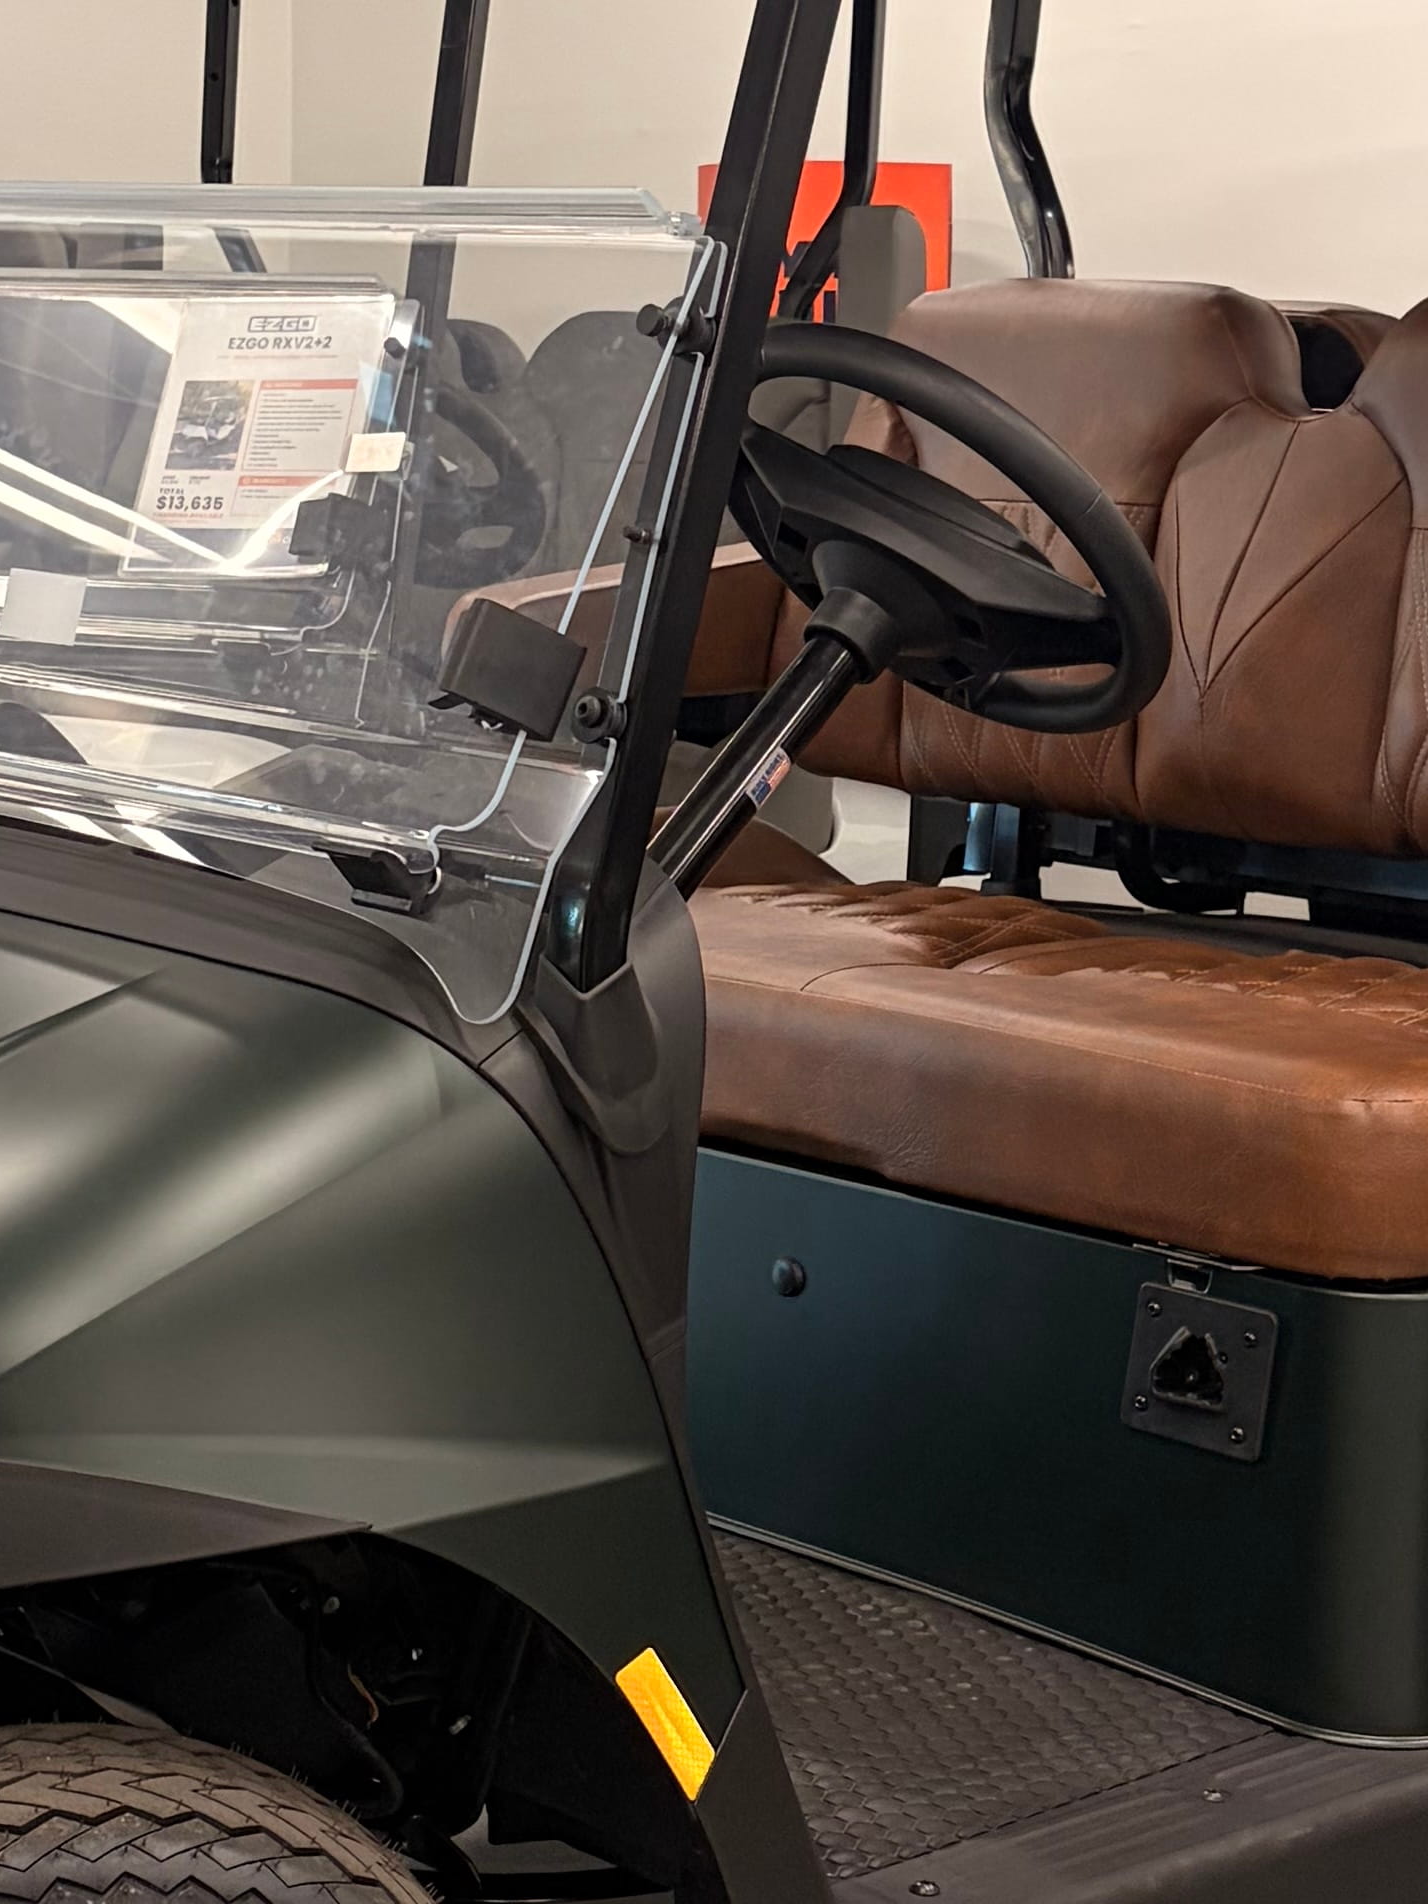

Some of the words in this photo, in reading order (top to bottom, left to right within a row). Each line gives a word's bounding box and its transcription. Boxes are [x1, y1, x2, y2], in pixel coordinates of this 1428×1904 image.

[248, 316, 317, 332] EZGO
[227, 336, 270, 350] EZGO
[156, 495, 223, 512] $13,635
